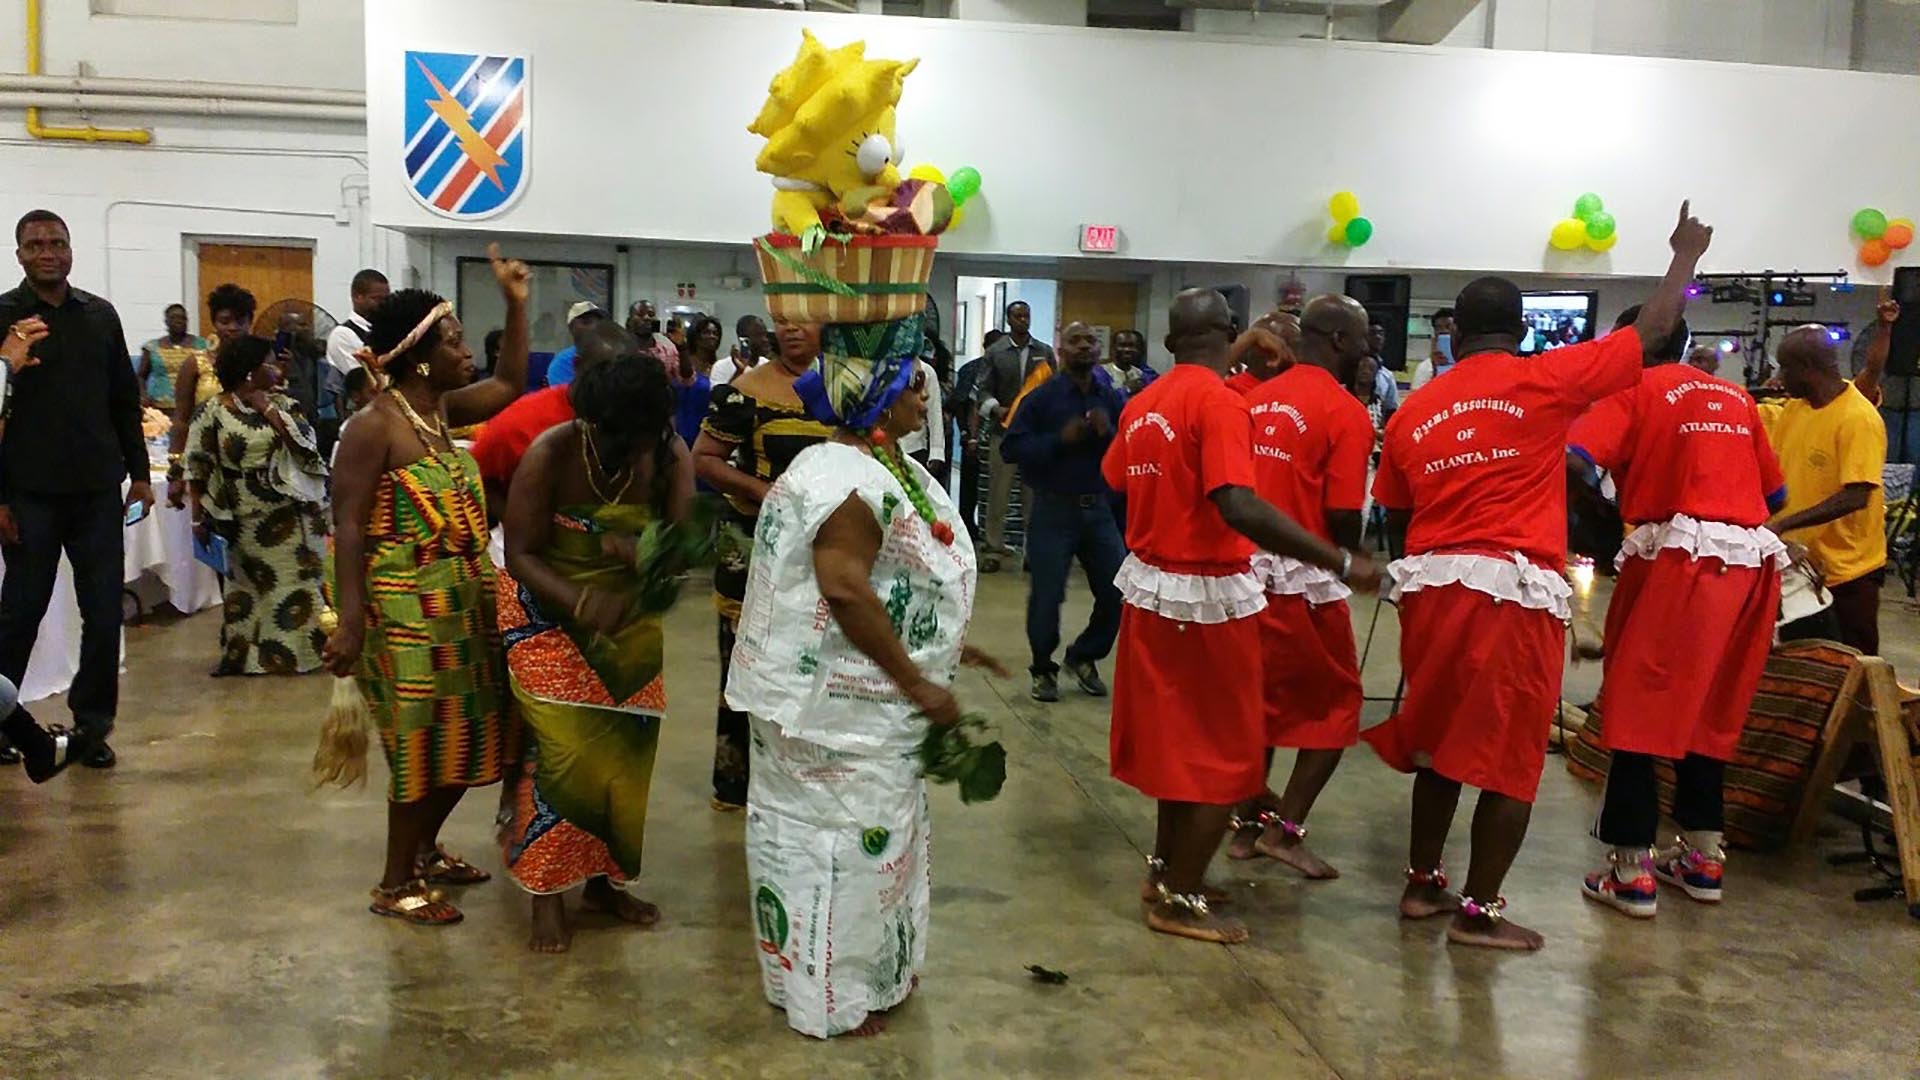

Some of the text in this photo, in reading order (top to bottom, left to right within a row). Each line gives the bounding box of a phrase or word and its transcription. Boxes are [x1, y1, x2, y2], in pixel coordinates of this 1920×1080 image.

[1087, 226, 1116, 250] EXIT
[1452, 397, 1525, 419] Association
[1707, 401, 1723, 411] OF
[1456, 427, 1476, 442] OF
[1491, 447, 1521, 459] Inc.
